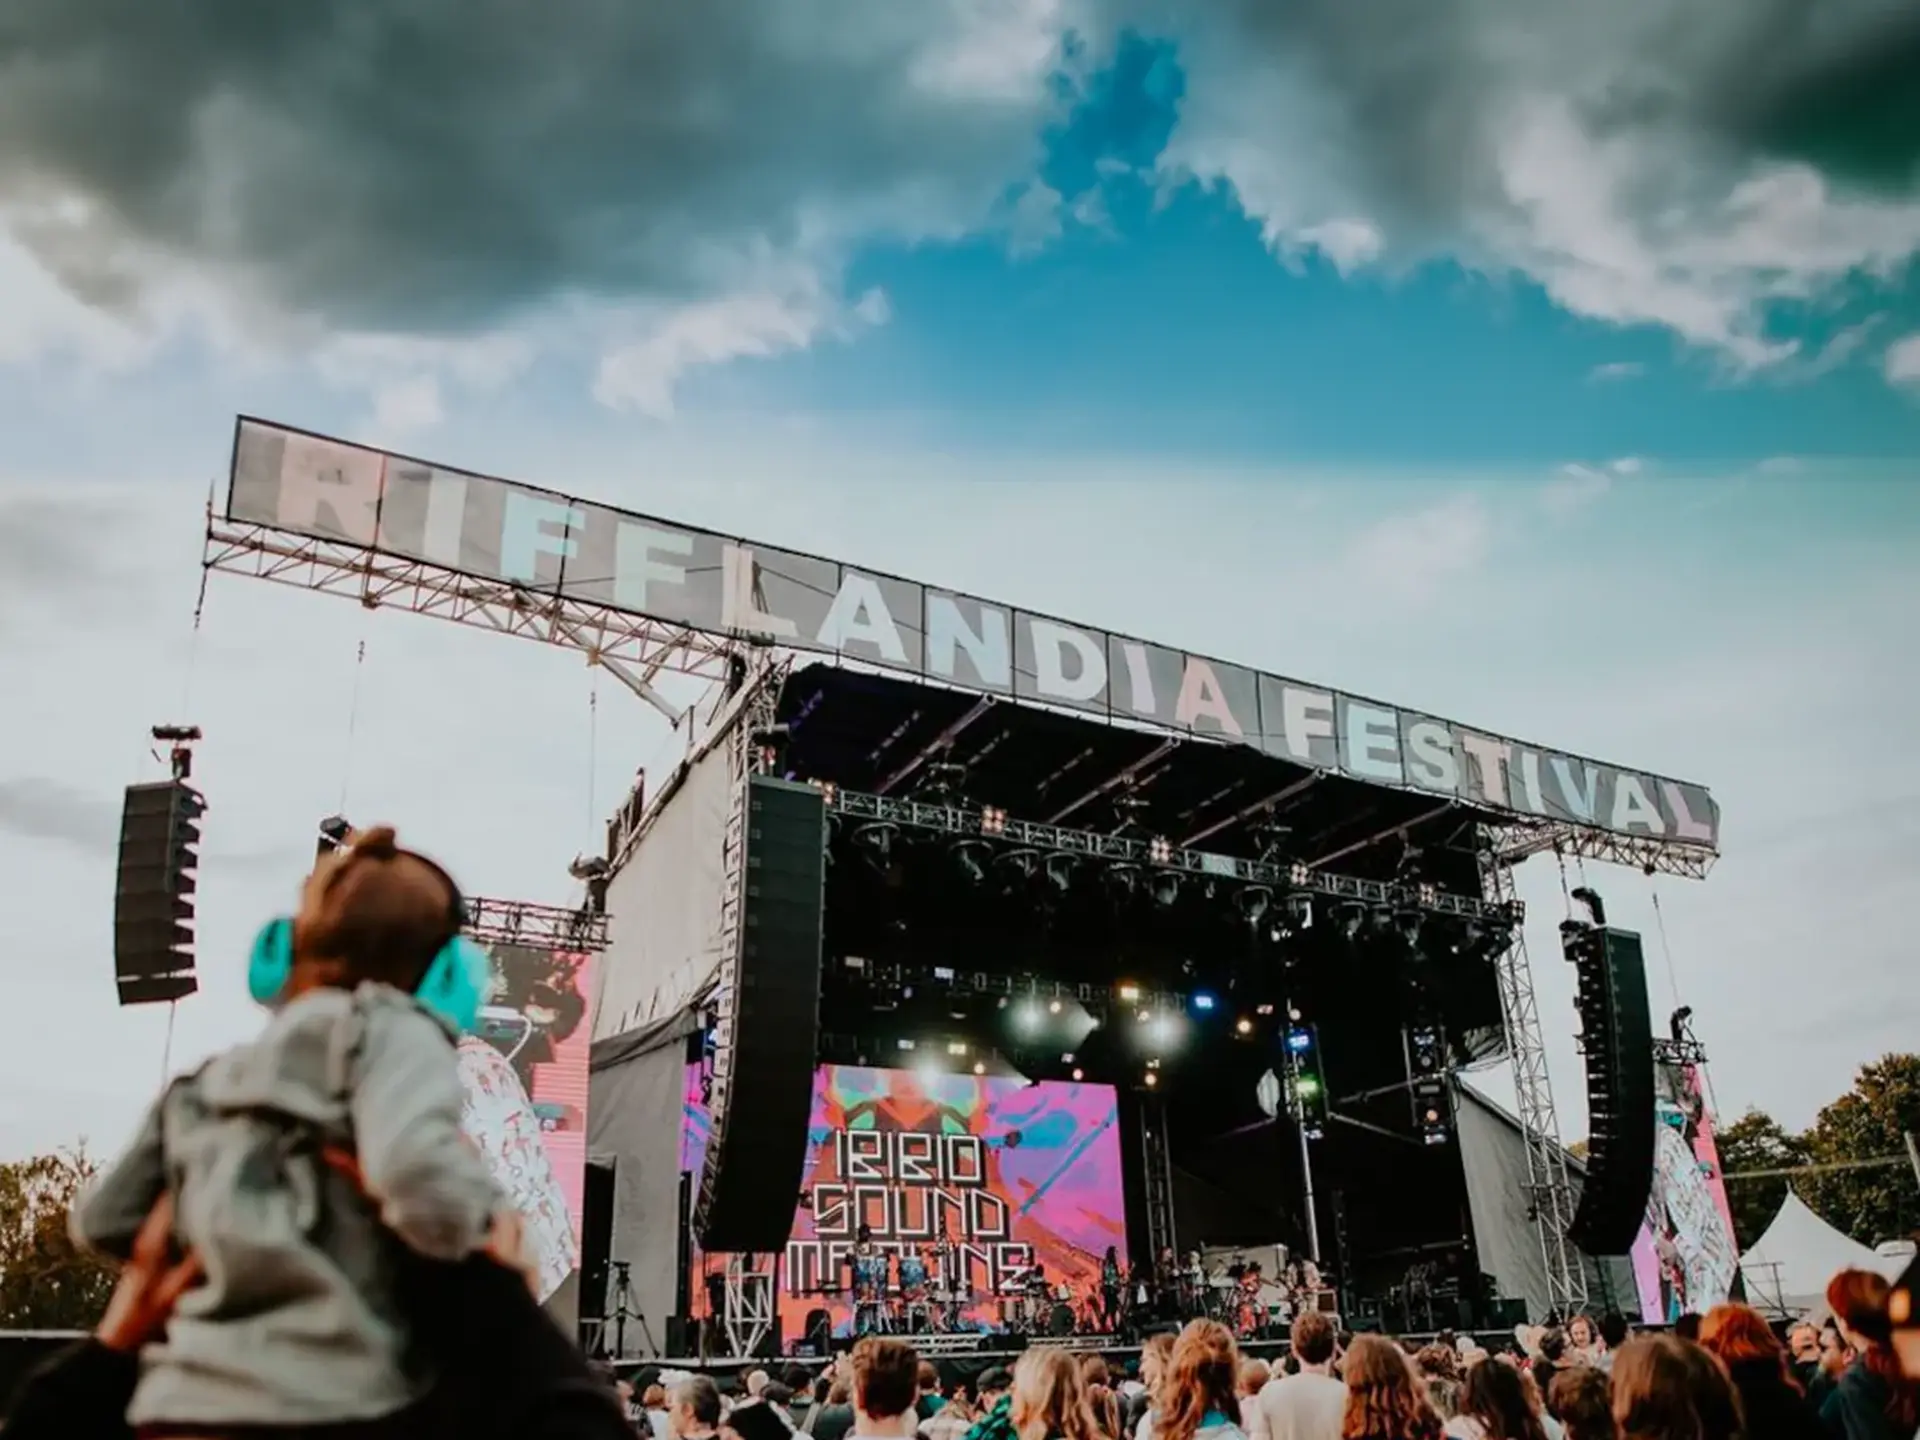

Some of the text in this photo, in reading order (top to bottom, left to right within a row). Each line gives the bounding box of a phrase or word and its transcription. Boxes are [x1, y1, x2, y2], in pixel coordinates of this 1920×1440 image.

[275, 431, 1712, 841] RIFFLANDIA FESTIVAL
[813, 1184, 1004, 1236] SOUND
